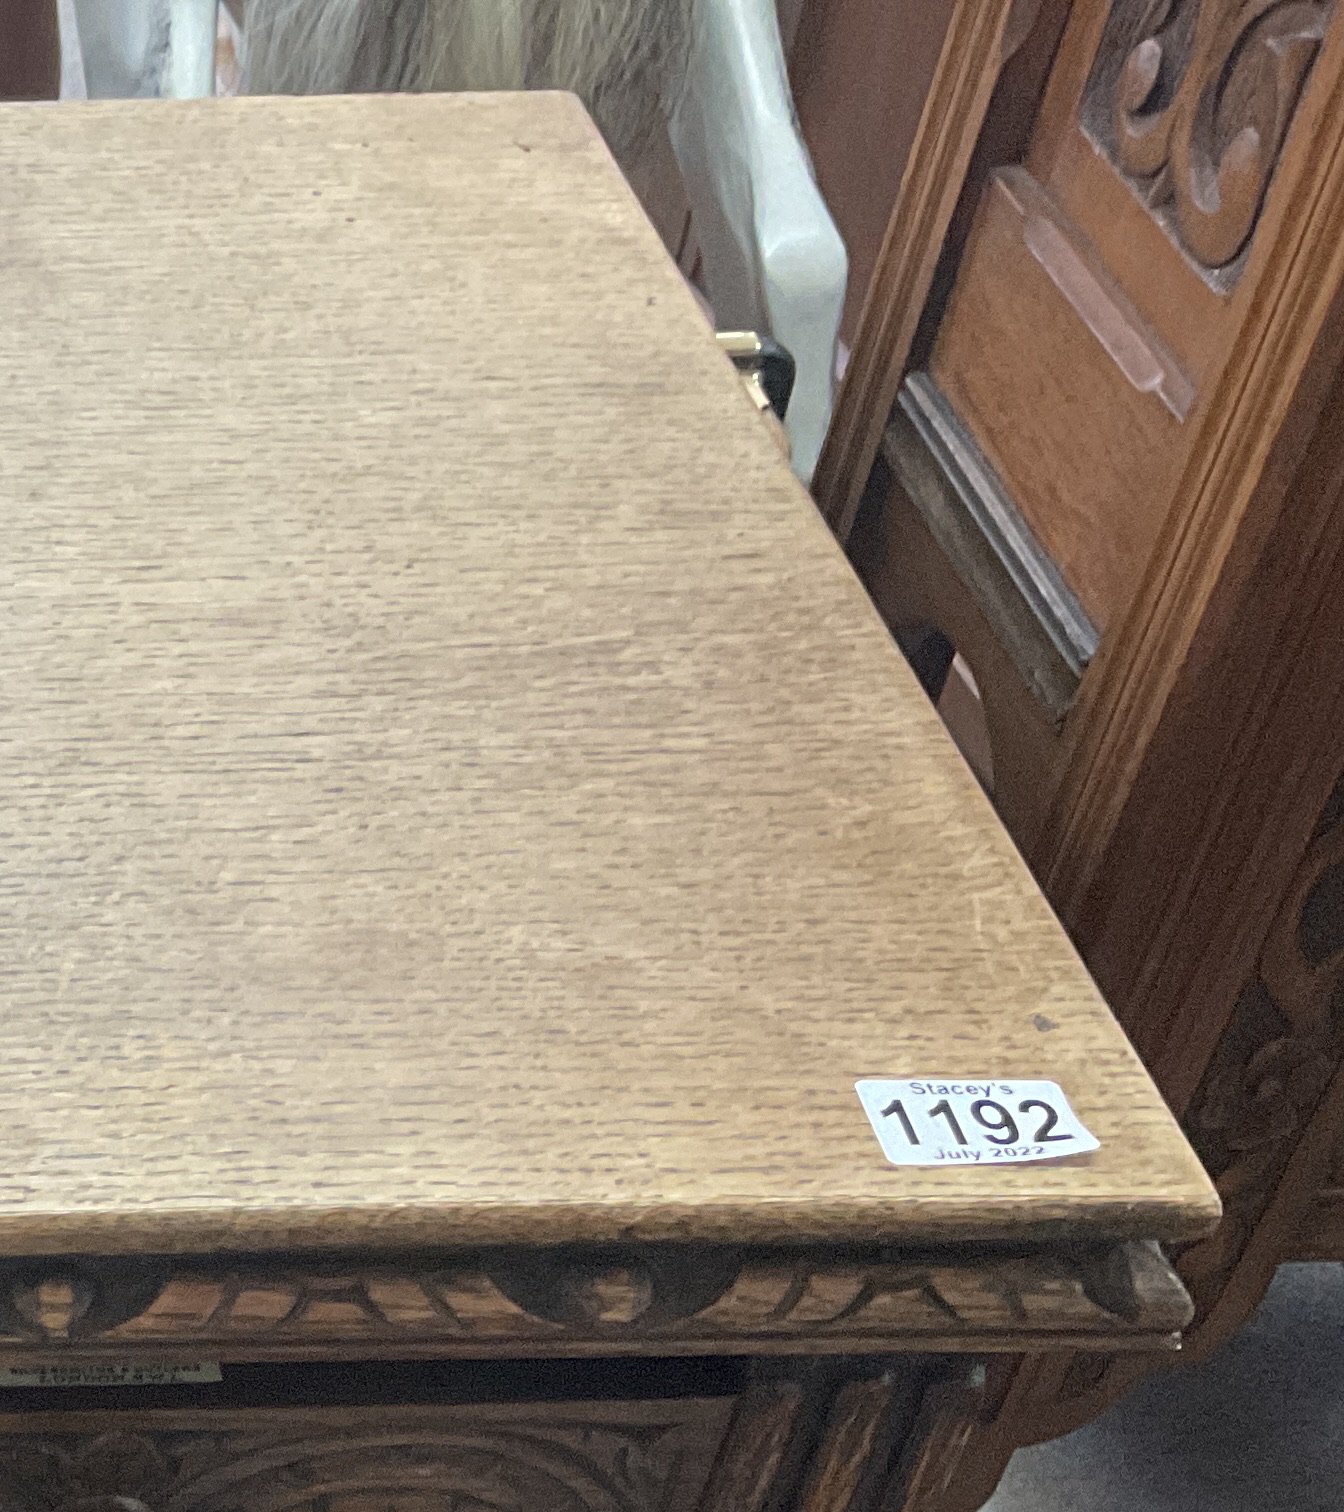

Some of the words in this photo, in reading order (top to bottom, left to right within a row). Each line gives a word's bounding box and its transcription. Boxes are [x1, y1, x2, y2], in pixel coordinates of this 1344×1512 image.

[909, 1081, 1014, 1098] Stacey's
[881, 1099, 1074, 1145] 1192
[933, 1147, 982, 1161] July
